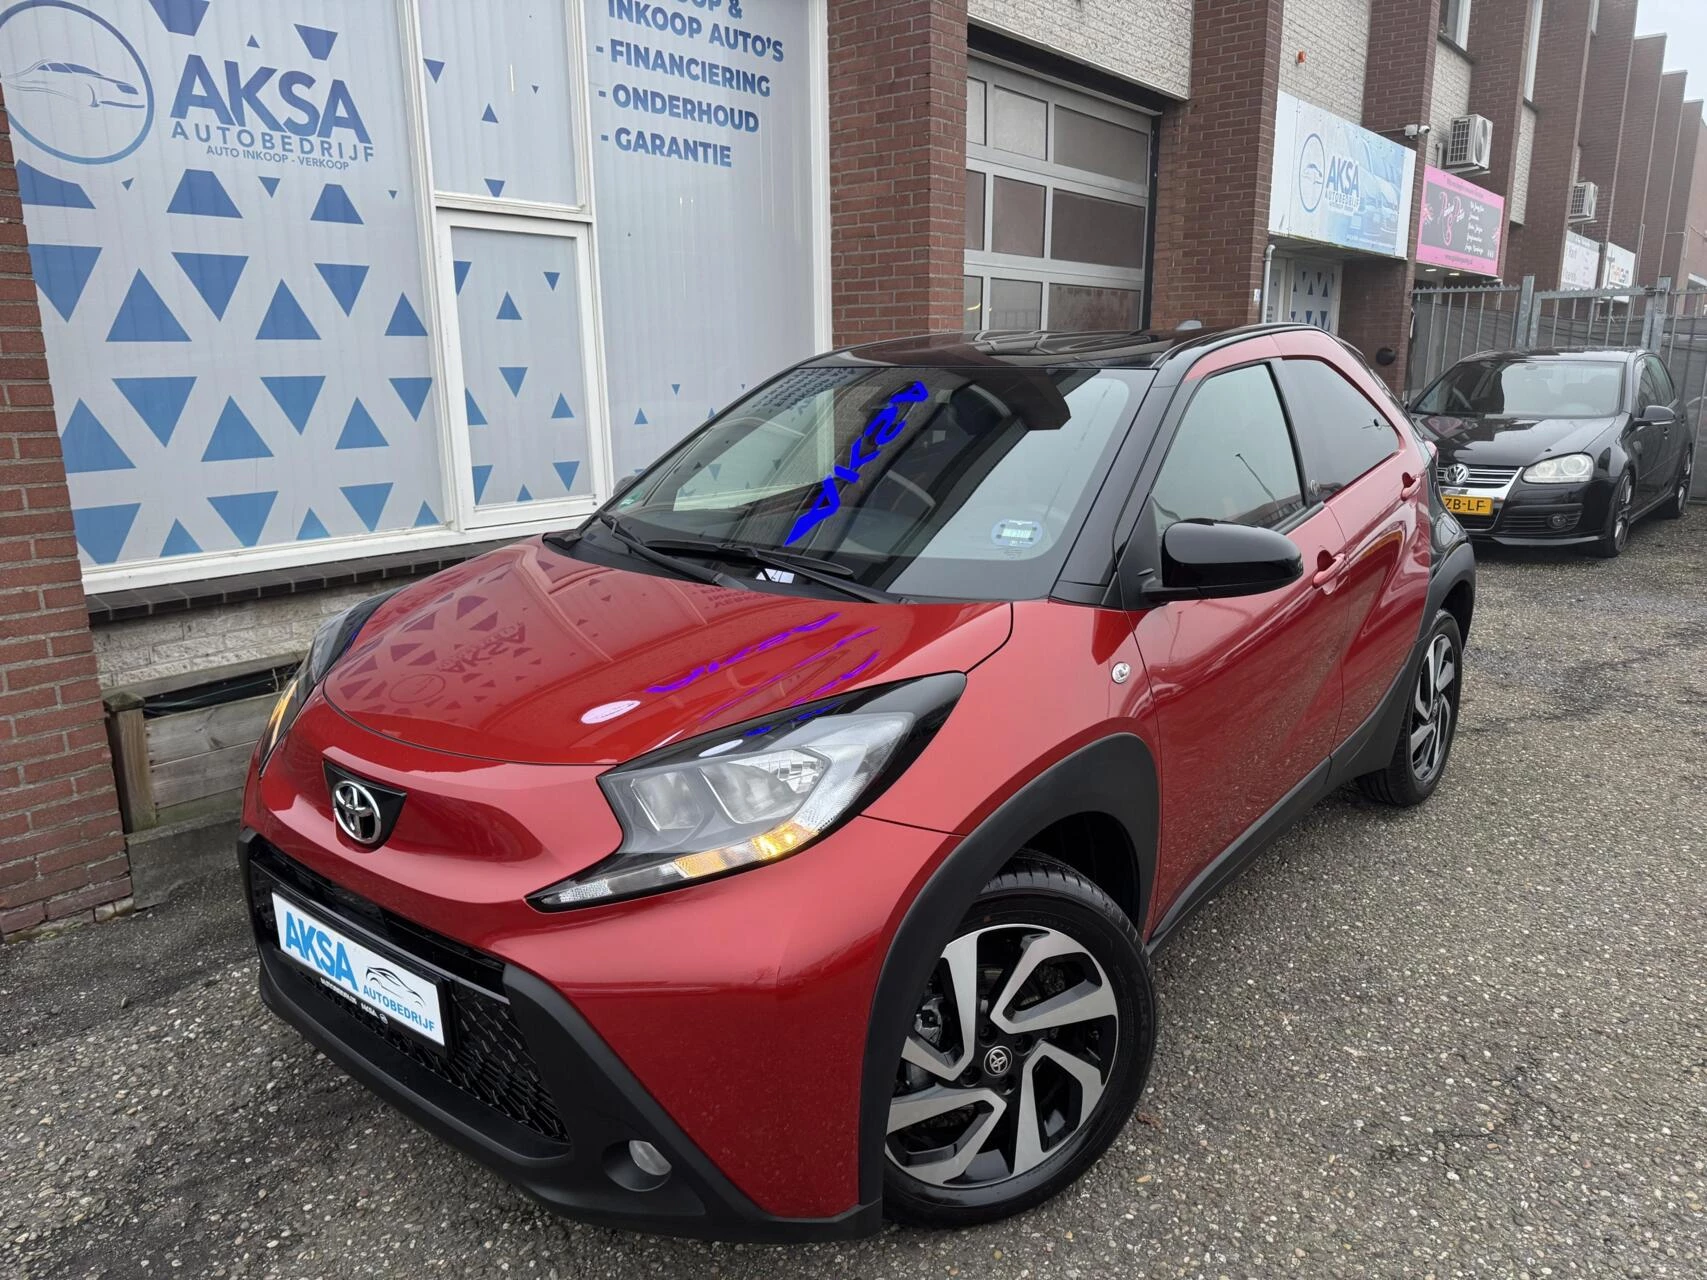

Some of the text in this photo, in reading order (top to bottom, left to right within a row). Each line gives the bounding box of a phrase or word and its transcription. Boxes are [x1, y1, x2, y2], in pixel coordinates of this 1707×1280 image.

[608, 0, 784, 62] INKOOP AUTO'S
[610, 39, 770, 97] FINANCIERING
[170, 53, 372, 145] AKSA
[612, 83, 759, 133] ONDERHOUD
[171, 120, 374, 162] AUTOBEDRIJF
[206, 145, 240, 158] AUTO
[243, 147, 289, 164] INKOOP
[298, 156, 349, 170] VERKOOP
[614, 127, 732, 168] GARANTIE
[1326, 156, 1359, 198] AKSA
[285, 911, 359, 992] AKSA
[363, 984, 435, 1032] AUTOBEDRIJF
